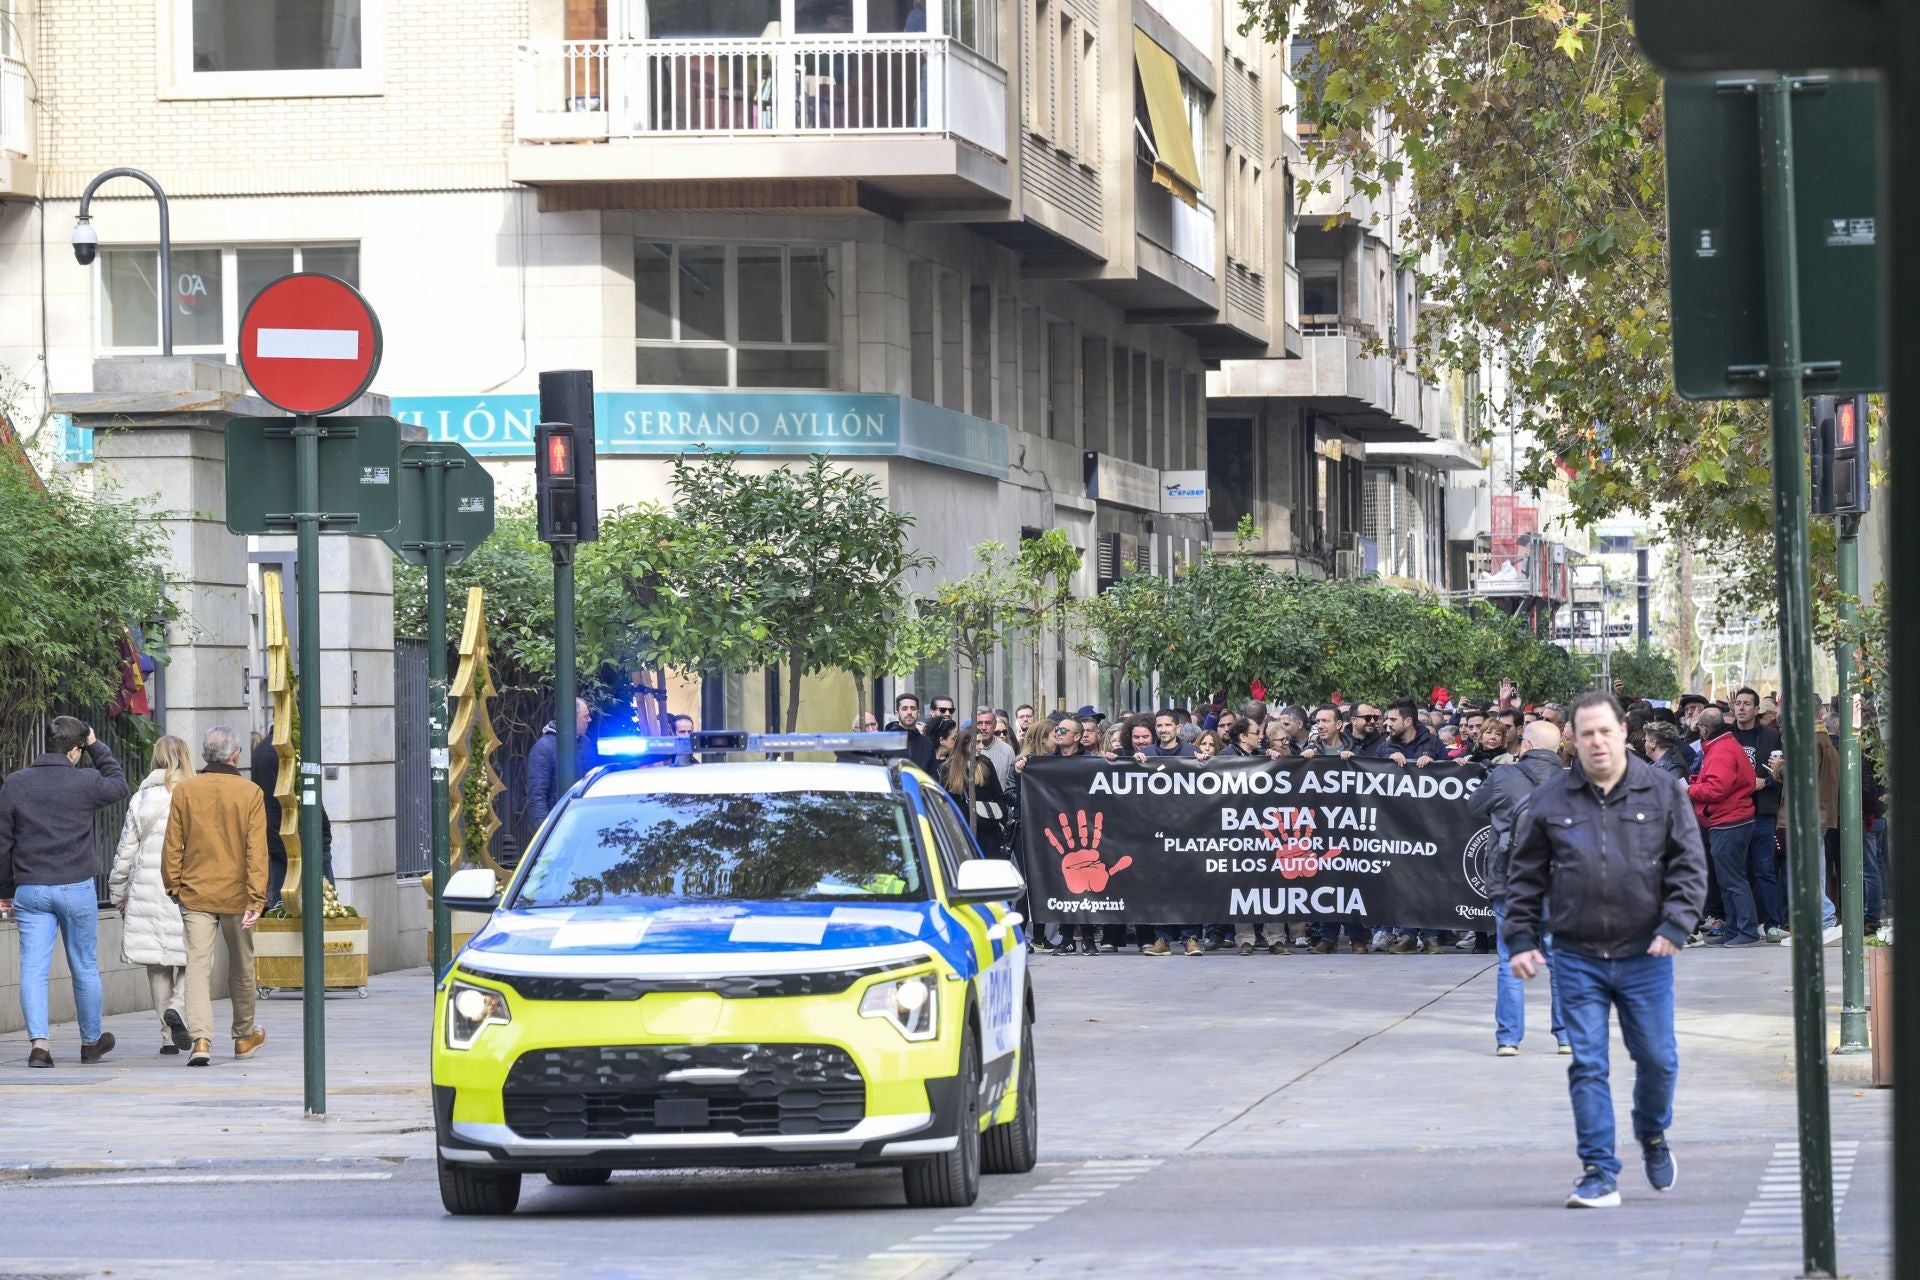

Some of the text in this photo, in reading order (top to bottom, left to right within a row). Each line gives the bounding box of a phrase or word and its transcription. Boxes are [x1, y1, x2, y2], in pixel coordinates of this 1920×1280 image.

[397, 402, 534, 442] LLÓN
[624, 408, 885, 437] SERRANO AYLLÓN
[1089, 764, 1482, 800] AUTÓNOMOS ASFIXIADOS
[1221, 806, 1377, 832] BASTA YA!!
[1287, 837, 1324, 851] POR
[1328, 837, 1351, 851] LA
[1353, 837, 1438, 856] DIGNIDAD
[1467, 830, 1490, 858] MANIFES
[1206, 859, 1228, 873] DE
[1232, 858, 1267, 872] LOS
[1471, 876, 1481, 888] DE
[1047, 896, 1125, 913] Copy&print
[1229, 886, 1367, 916] MURCIA
